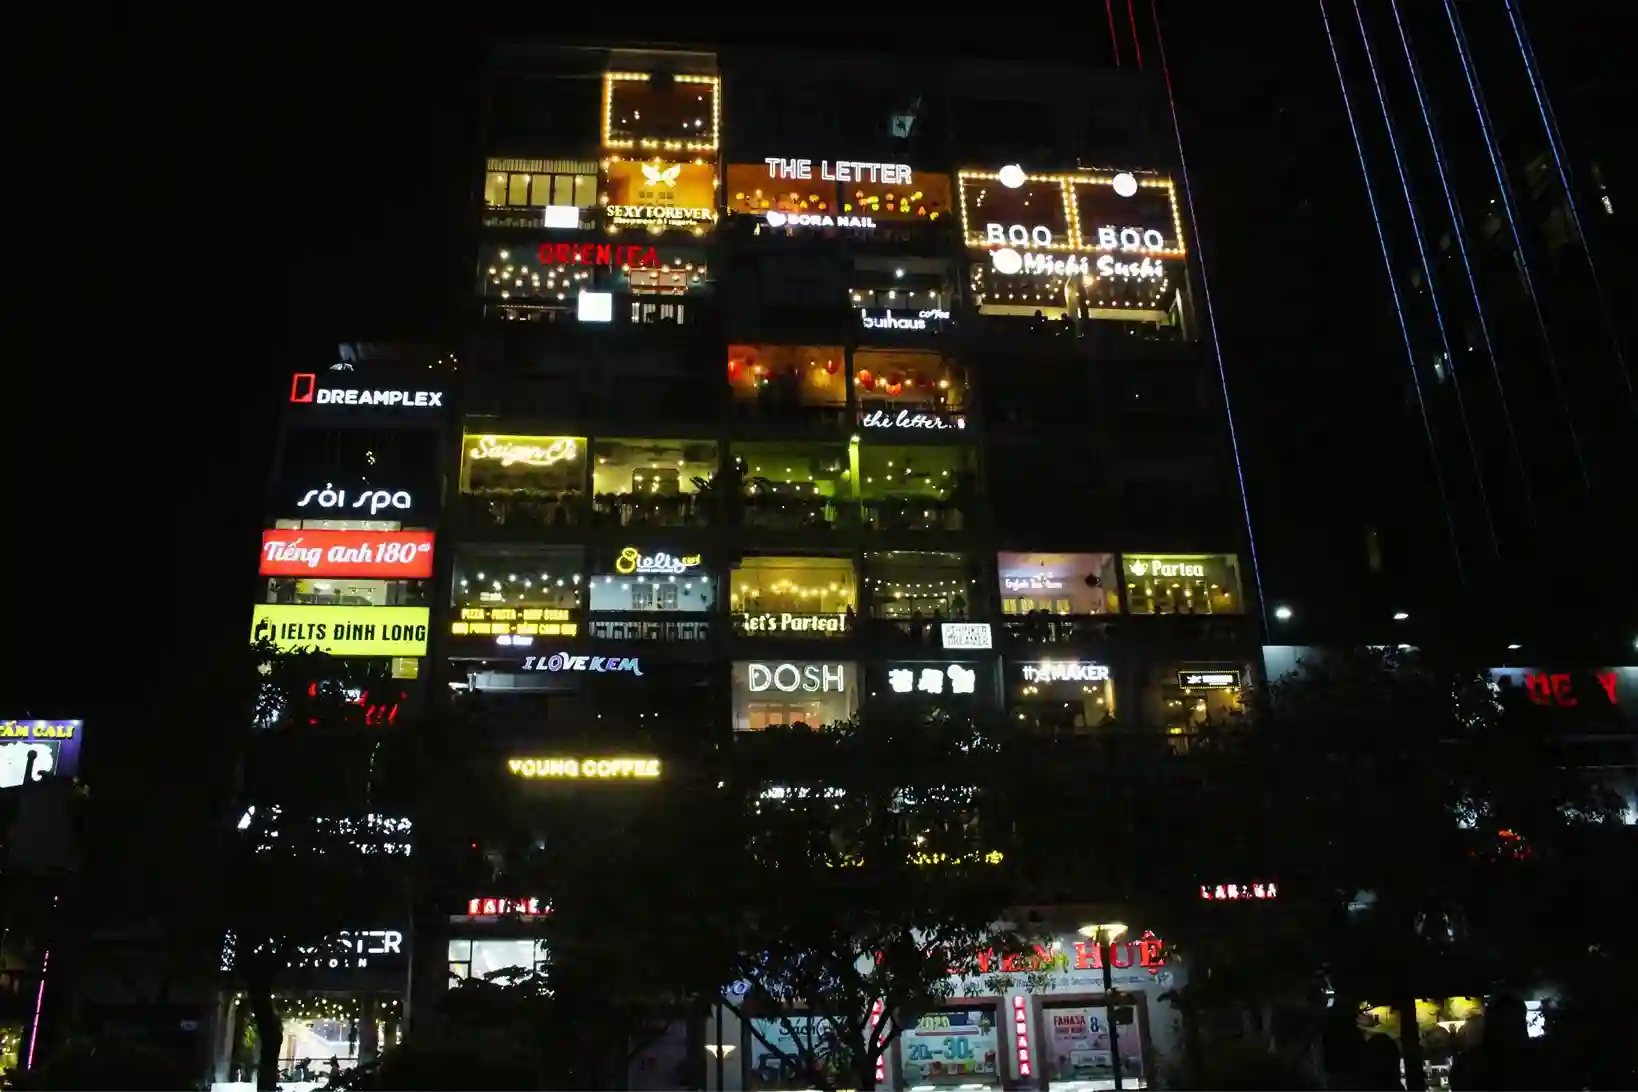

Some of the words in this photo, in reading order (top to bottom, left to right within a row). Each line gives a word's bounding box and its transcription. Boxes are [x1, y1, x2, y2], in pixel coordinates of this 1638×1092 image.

[765, 158, 812, 180] THE
[822, 160, 912, 184] LETTER
[606, 205, 641, 218] SEXY
[647, 206, 712, 219] FOREVER
[788, 214, 834, 226] BORA
[837, 215, 876, 228] NAIL
[986, 223, 1052, 248] BOO
[1098, 227, 1164, 251] BOO
[1097, 255, 1164, 278] Sushi
[316, 388, 443, 407] DREAMPLEX
[863, 410, 894, 428] the
[352, 490, 412, 515] spa
[264, 538, 323, 568] Tiếng
[281, 623, 327, 640] IELTS
[382, 624, 426, 642] LONG
[522, 656, 536, 670] I
[536, 652, 586, 672] LOVE
[589, 656, 644, 676] KEM
[748, 663, 844, 692] DOSH
[32, 725, 75, 738] CALI
[508, 759, 580, 777] YOUNG
[582, 759, 661, 777] COFFEE
